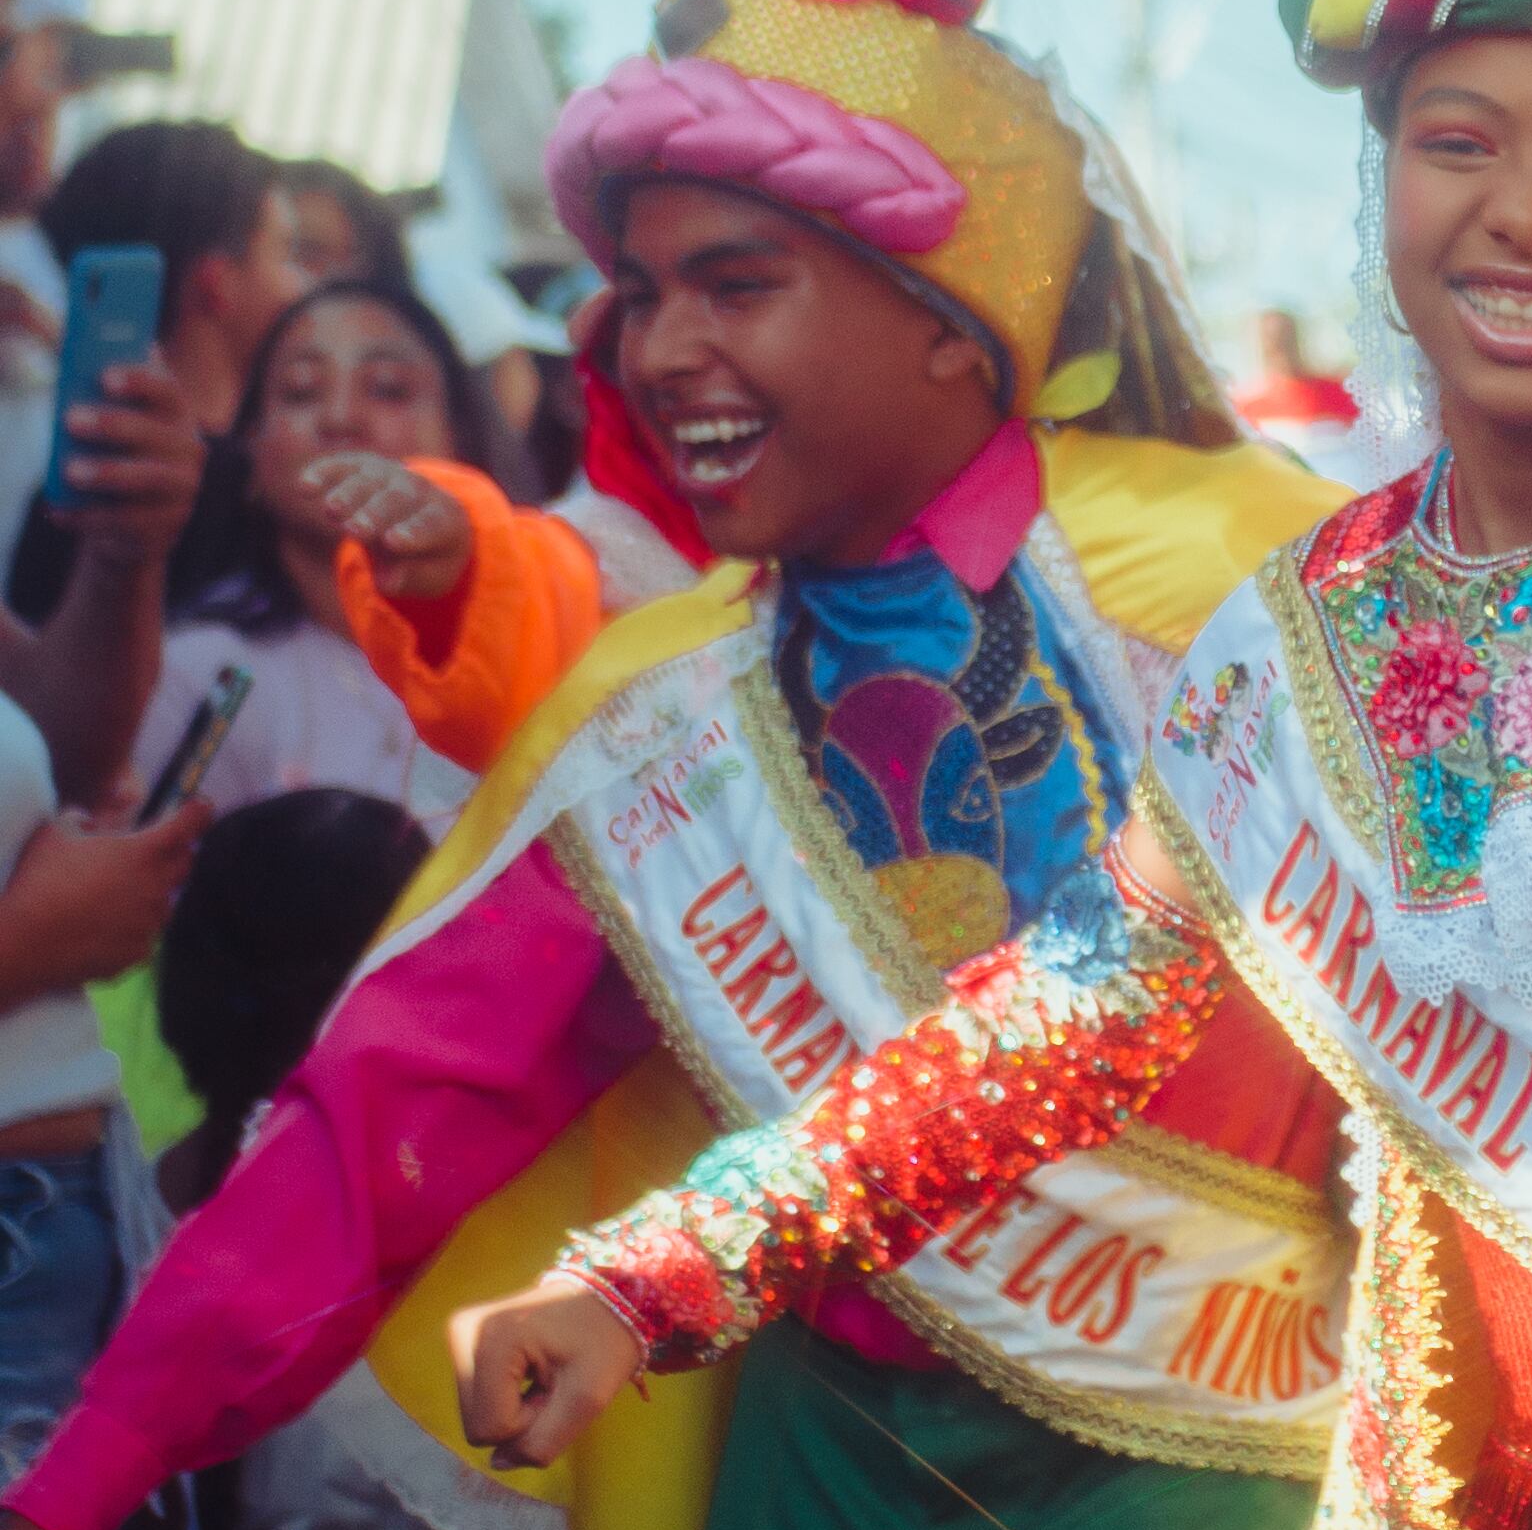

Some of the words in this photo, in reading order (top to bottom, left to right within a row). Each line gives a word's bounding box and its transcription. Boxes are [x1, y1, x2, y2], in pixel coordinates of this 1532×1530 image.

[681, 862, 862, 1095] CARNA
[999, 1213, 1168, 1345] LOS
[1166, 1267, 1342, 1403] NIÑOS
